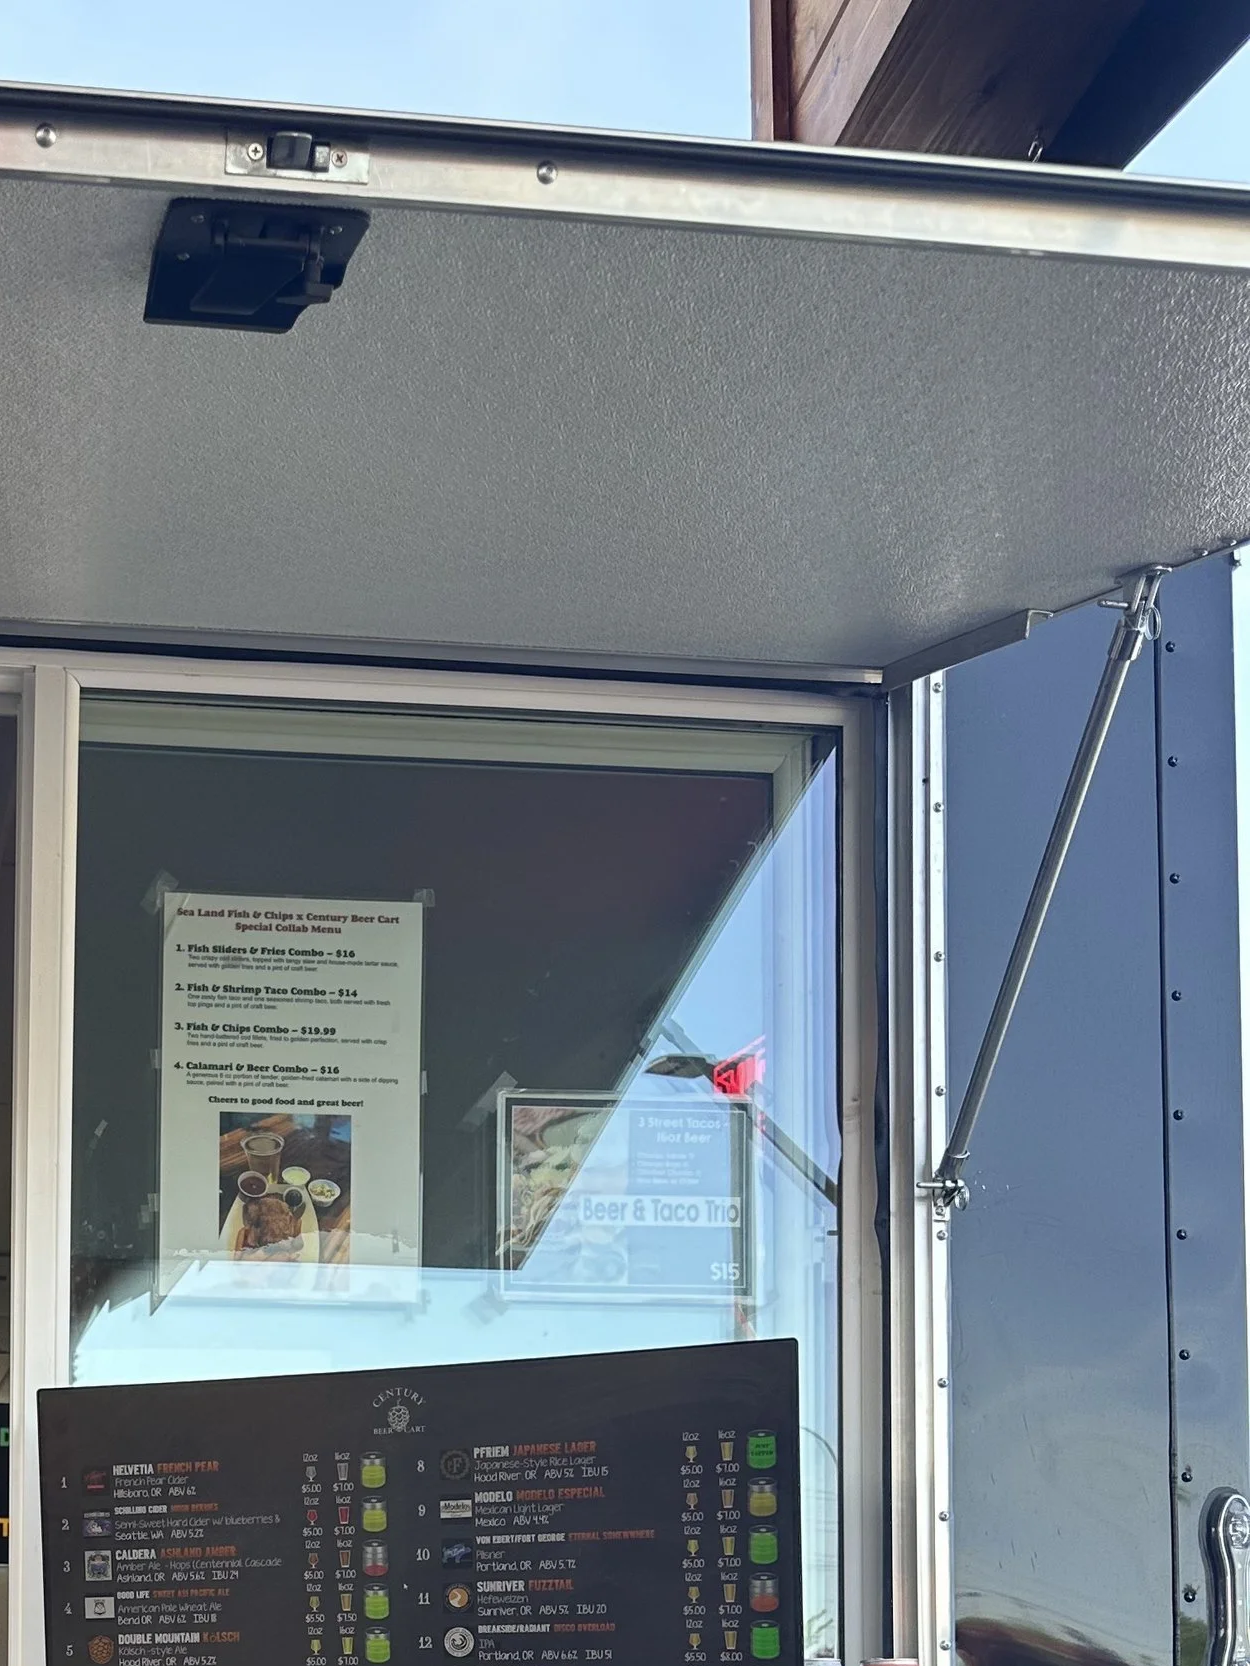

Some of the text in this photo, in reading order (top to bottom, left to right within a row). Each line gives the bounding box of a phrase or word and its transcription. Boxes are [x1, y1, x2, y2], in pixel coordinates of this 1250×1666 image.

[177, 908, 194, 916] Sea
[198, 909, 224, 917] Land
[228, 910, 250, 918] Fish
[253, 911, 261, 919] &
[264, 911, 293, 921] Chips
[307, 913, 348, 923] Century
[351, 915, 375, 923] Beer
[378, 915, 399, 924] Cart
[235, 923, 341, 934] Special Collab Menu
[176, 944, 355, 957] 1. Fish Sliders & Fries Combo $16
[175, 983, 184, 991] 2.
[188, 983, 208, 992] Fish
[223, 985, 261, 995] Shrimp
[264, 986, 288, 994] Taco
[291, 987, 326, 996] Combo
[338, 989, 357, 997] $14
[174, 1022, 183, 1030] 3.
[187, 1023, 208, 1031] Fish
[222, 1024, 250, 1034] Chips
[253, 1025, 289, 1033] Combo
[301, 1027, 336, 1035] $19.99
[186, 1062, 232, 1071] Calamari
[236, 1063, 244, 1071] &
[247, 1064, 270, 1072] Beer
[273, 1064, 308, 1073] Combo
[320, 1066, 339, 1074] $16
[209, 1096, 238, 1104] Cheers
[252, 1097, 273, 1105] good
[275, 1097, 295, 1105] food
[317, 1099, 339, 1107] great
[342, 1099, 363, 1107] beer!
[648, 1117, 684, 1129] Street
[583, 1199, 739, 1222] Beer & Taco Trio
[710, 1262, 740, 1282] $15
[372, 1387, 425, 1408] CENTURY
[374, 1425, 426, 1435] BEER CART
[474, 1441, 596, 1459] PFRIEM JAPANESE LAGER
[61, 1461, 219, 1488] 1 HELVETIA FRENCH PEAR
[302, 1482, 354, 1493] $5.00 $7.00
[475, 1486, 604, 1503] MODELO MODELO ESPECIAL
[63, 1549, 156, 1572] 3 CALDERA
[477, 1579, 574, 1593] SUNRIVER FUZZTAIL
[66, 1645, 73, 1656] 5
[118, 1634, 152, 1645] DOUBLE
[155, 1632, 200, 1644] MOUNTAIN
